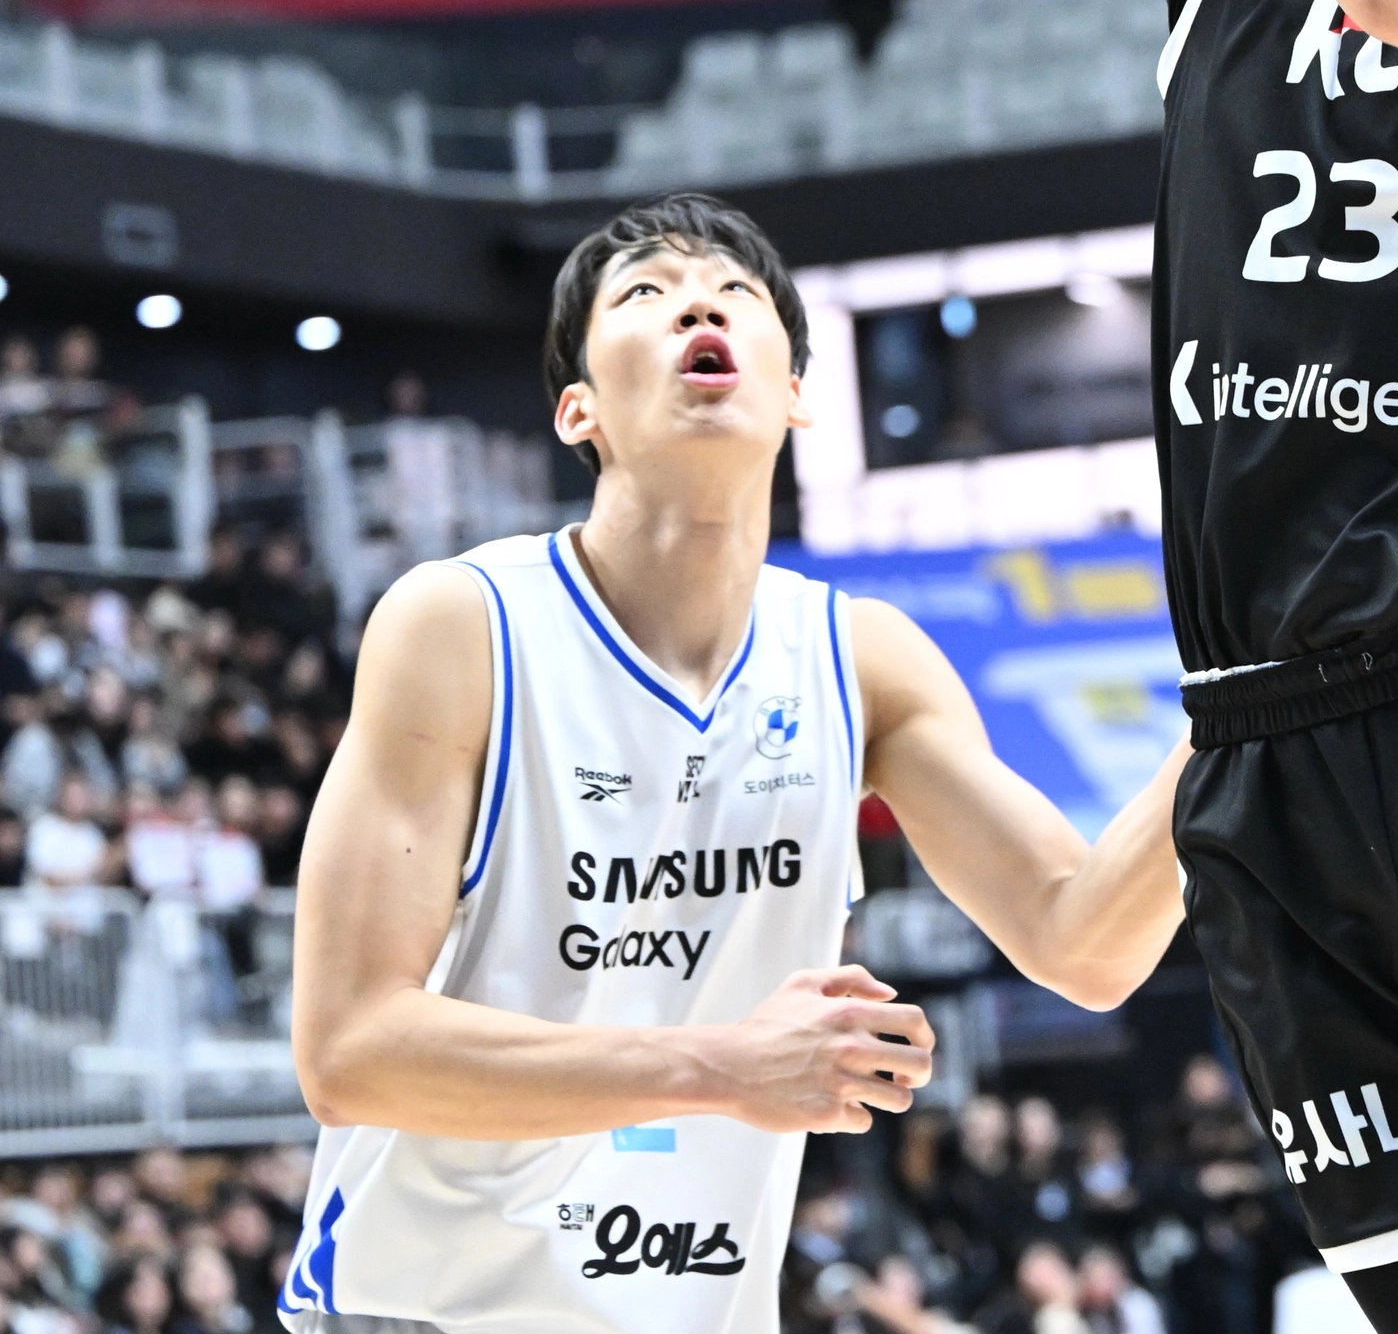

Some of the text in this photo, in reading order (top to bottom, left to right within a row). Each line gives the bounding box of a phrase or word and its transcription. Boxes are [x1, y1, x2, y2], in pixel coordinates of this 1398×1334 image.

[574, 767, 633, 786] Reebok
[567, 839, 801, 904] SAMSUNG
[559, 924, 711, 980] Galaxy
[581, 1204, 746, 1279] 오예스
